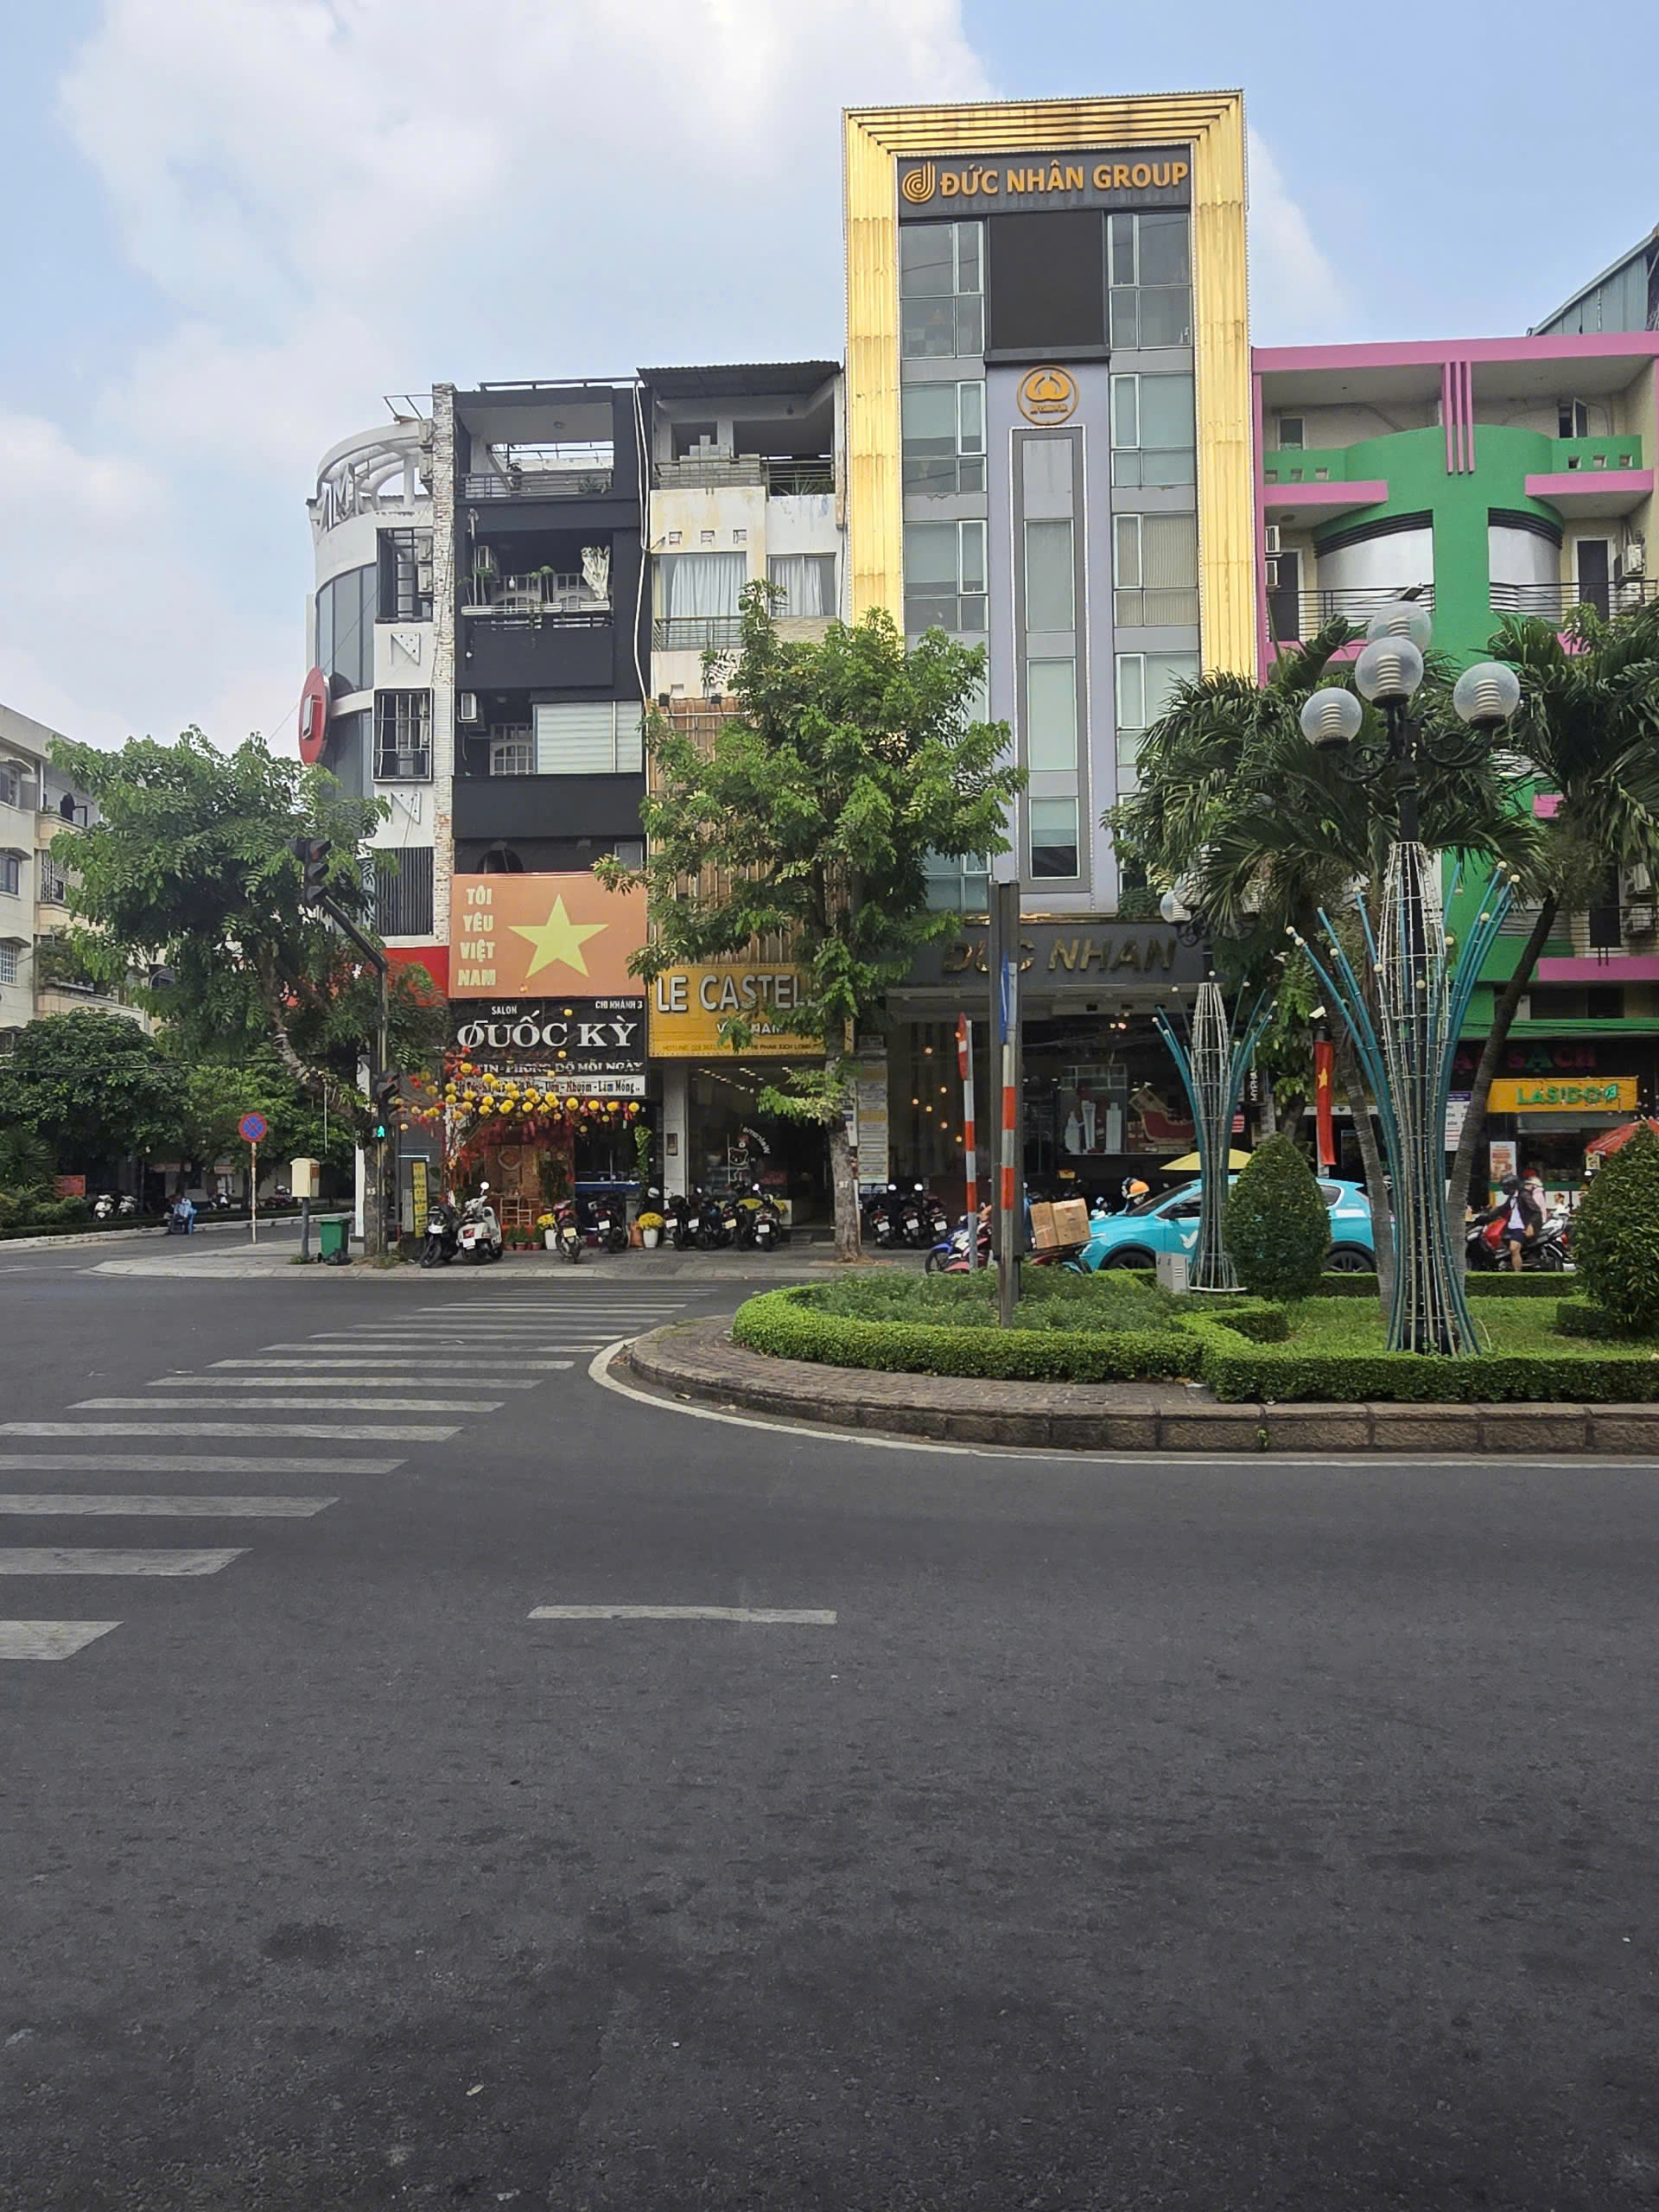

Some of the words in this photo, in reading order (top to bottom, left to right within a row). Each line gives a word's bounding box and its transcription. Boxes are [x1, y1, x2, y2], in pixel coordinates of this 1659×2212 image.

[940, 163, 998, 196] ĐỨC
[1007, 159, 1084, 194] NHÂN
[1093, 162, 1189, 188] GROUP
[466, 884, 493, 906] TÔI
[462, 912, 493, 932] YÊU
[460, 938, 496, 963] VIỆT
[457, 969, 496, 986] NAM
[637, 1000, 644, 1009] 3
[656, 976, 688, 1012] LE
[491, 1004, 518, 1015] SALON
[576, 1014, 638, 1047] KỲ
